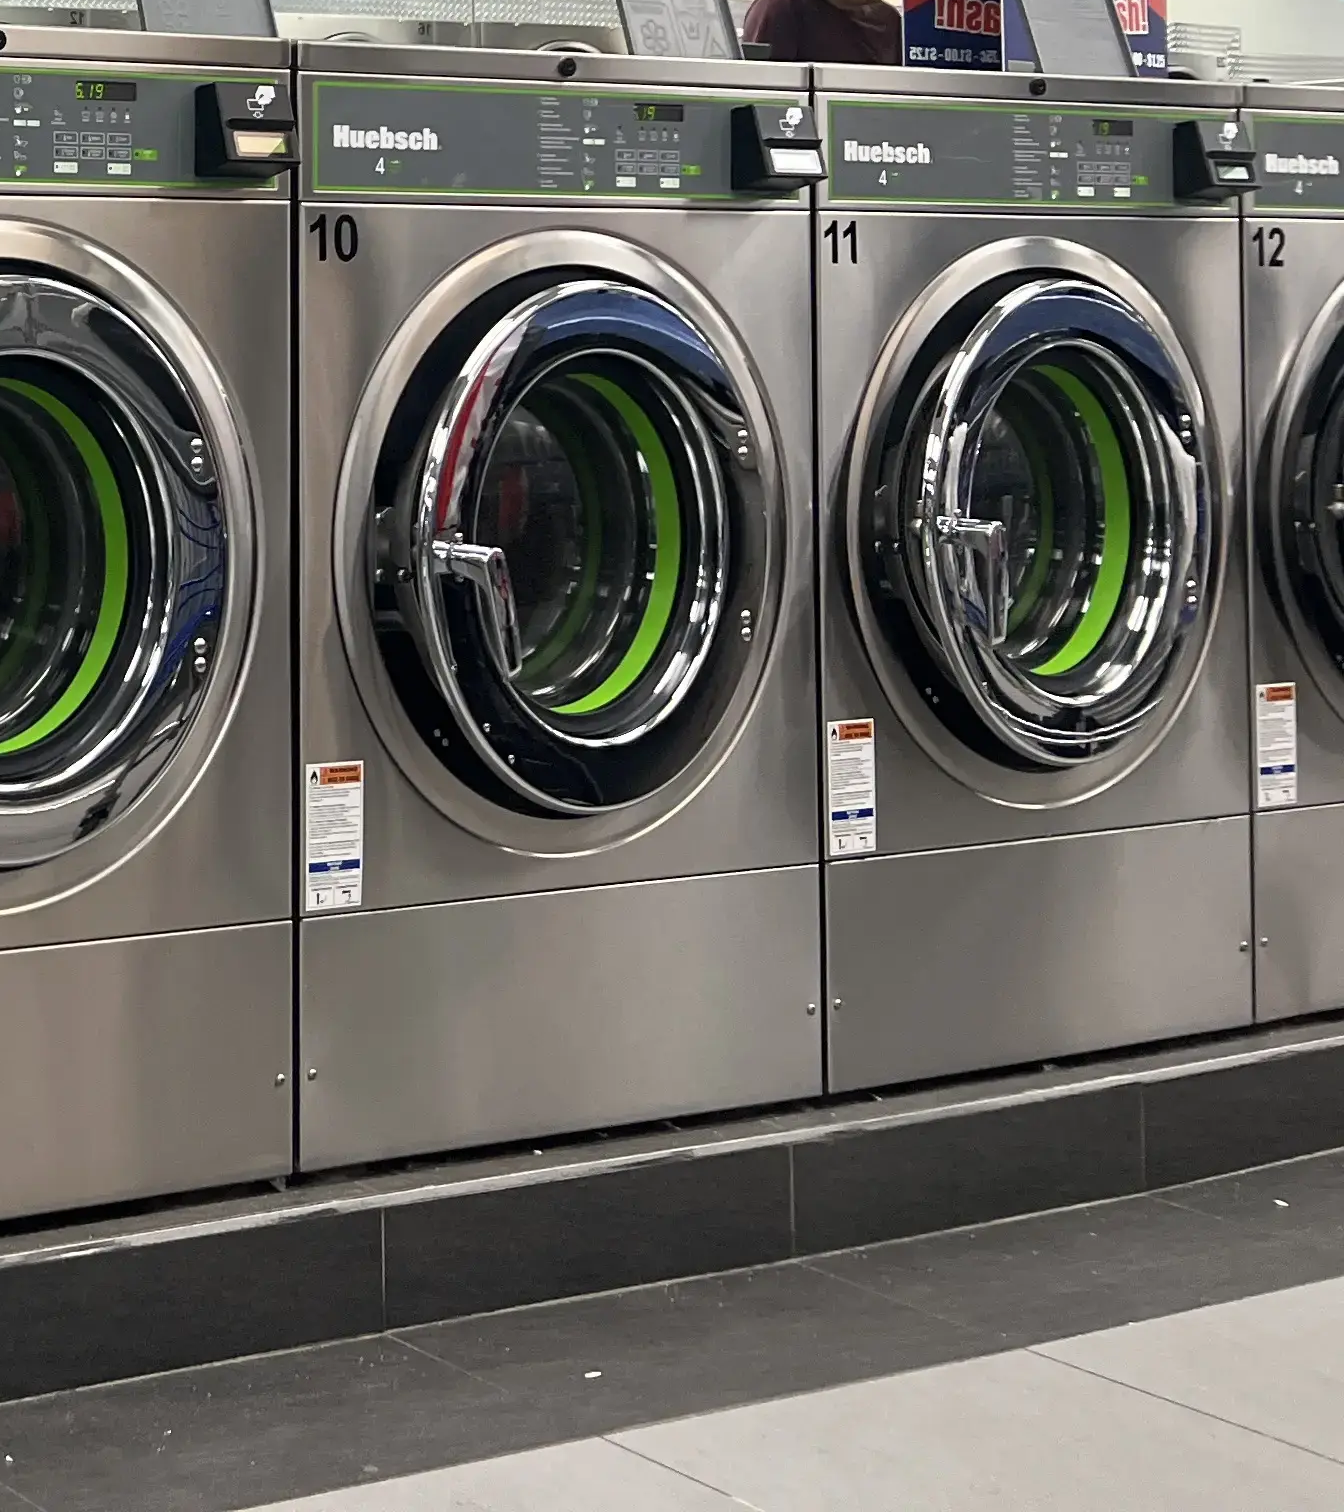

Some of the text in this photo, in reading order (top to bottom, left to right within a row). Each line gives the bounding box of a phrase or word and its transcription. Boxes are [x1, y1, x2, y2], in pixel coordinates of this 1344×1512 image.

[332, 124, 439, 151] Huebsch
[374, 155, 385, 175] 4
[843, 140, 932, 165] Huebsch
[1265, 153, 1340, 175] Huebsch
[877, 169, 887, 187] 4
[308, 212, 359, 263] 10
[823, 219, 859, 265] 11
[1252, 226, 1286, 267] 12
